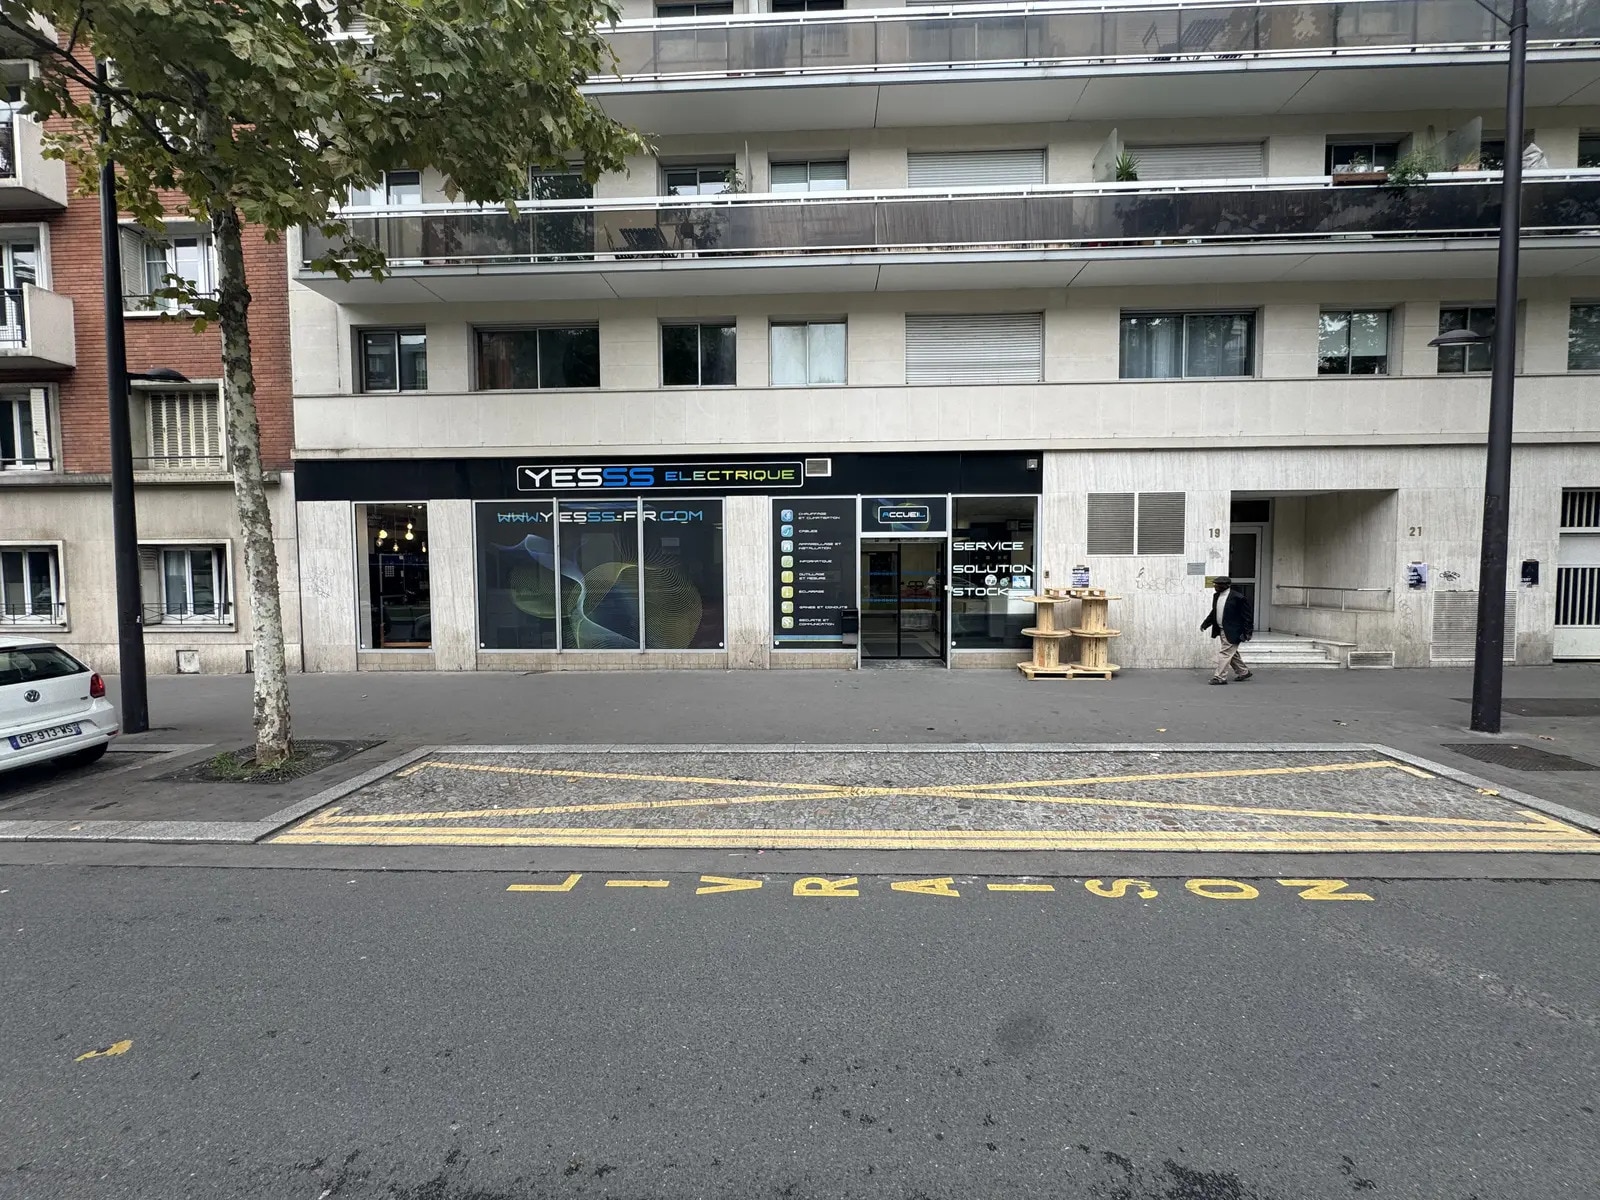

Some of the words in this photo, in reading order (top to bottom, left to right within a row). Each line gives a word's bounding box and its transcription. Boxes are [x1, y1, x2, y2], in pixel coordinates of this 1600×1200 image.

[524, 467, 655, 488] YESSS
[664, 469, 795, 482] ELECTRIQUE
[1208, 528, 1221, 538] 19
[1409, 526, 1422, 537] 21
[953, 541, 1024, 551] SERVICE
[952, 564, 1035, 574] SOLUTION
[952, 587, 1010, 597] STOCK
[19, 724, 73, 744] GB-913-WS
